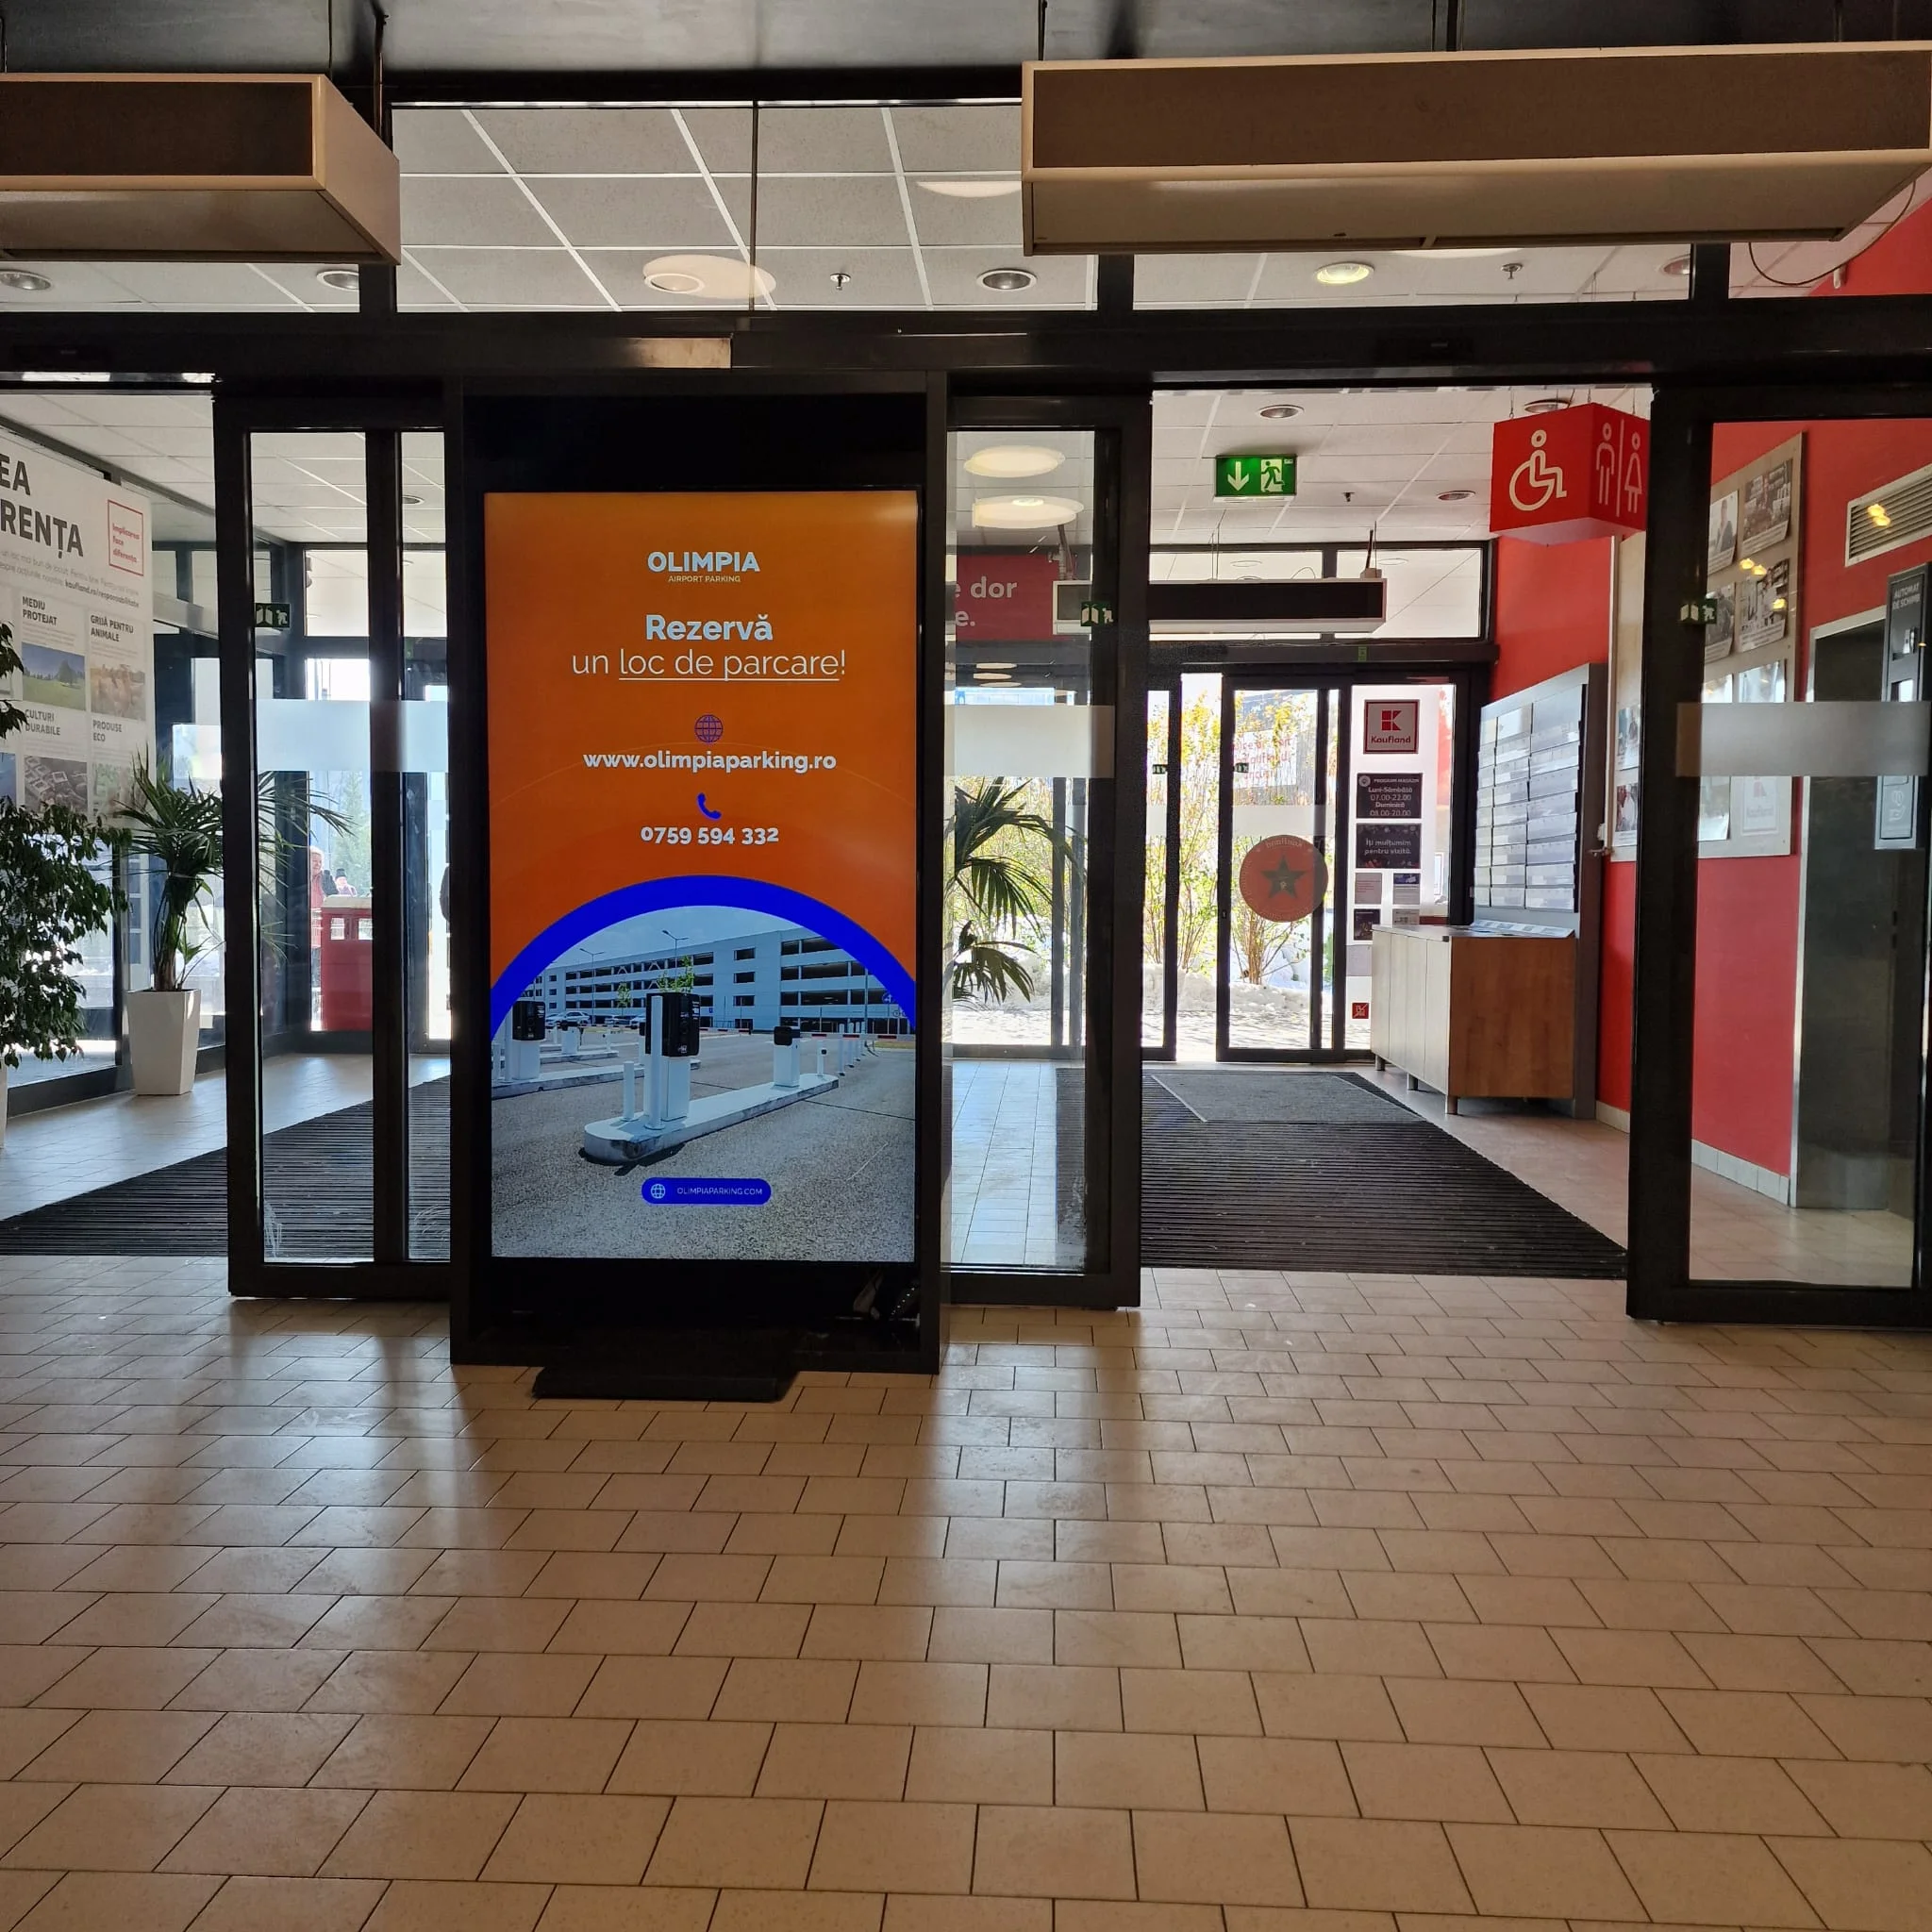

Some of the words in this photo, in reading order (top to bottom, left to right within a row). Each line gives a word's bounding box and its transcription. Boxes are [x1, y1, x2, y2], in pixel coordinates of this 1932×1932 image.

[0, 498, 84, 559] RENȚA
[647, 551, 761, 573] OLIMPIA
[668, 575, 704, 583] AIRPORT
[705, 575, 741, 583] PARKING
[970, 575, 1018, 598] dor
[22, 595, 46, 610] MEDIU
[22, 608, 58, 626] PROTEJAT
[90, 626, 120, 642] ANIMALE
[109, 619, 134, 634] PENTRU
[645, 613, 774, 641] Rezervă
[572, 653, 609, 675] un
[619, 648, 665, 675] loc
[674, 648, 714, 675] de
[724, 648, 846, 682] parcare!
[25, 708, 55, 722] CULTURI
[25, 723, 61, 736] DURABILE
[92, 719, 122, 733] PRODUSE
[92, 732, 106, 741] ECO
[1371, 735, 1411, 744] Kaufland
[582, 750, 838, 774] www.olimpiaparking.ro
[641, 826, 692, 845] 0759
[697, 826, 736, 845] 594
[741, 826, 779, 845] 332
[1364, 847, 1390, 856] pentru
[676, 1187, 763, 1195] OLIMPIAPARKING.COM
